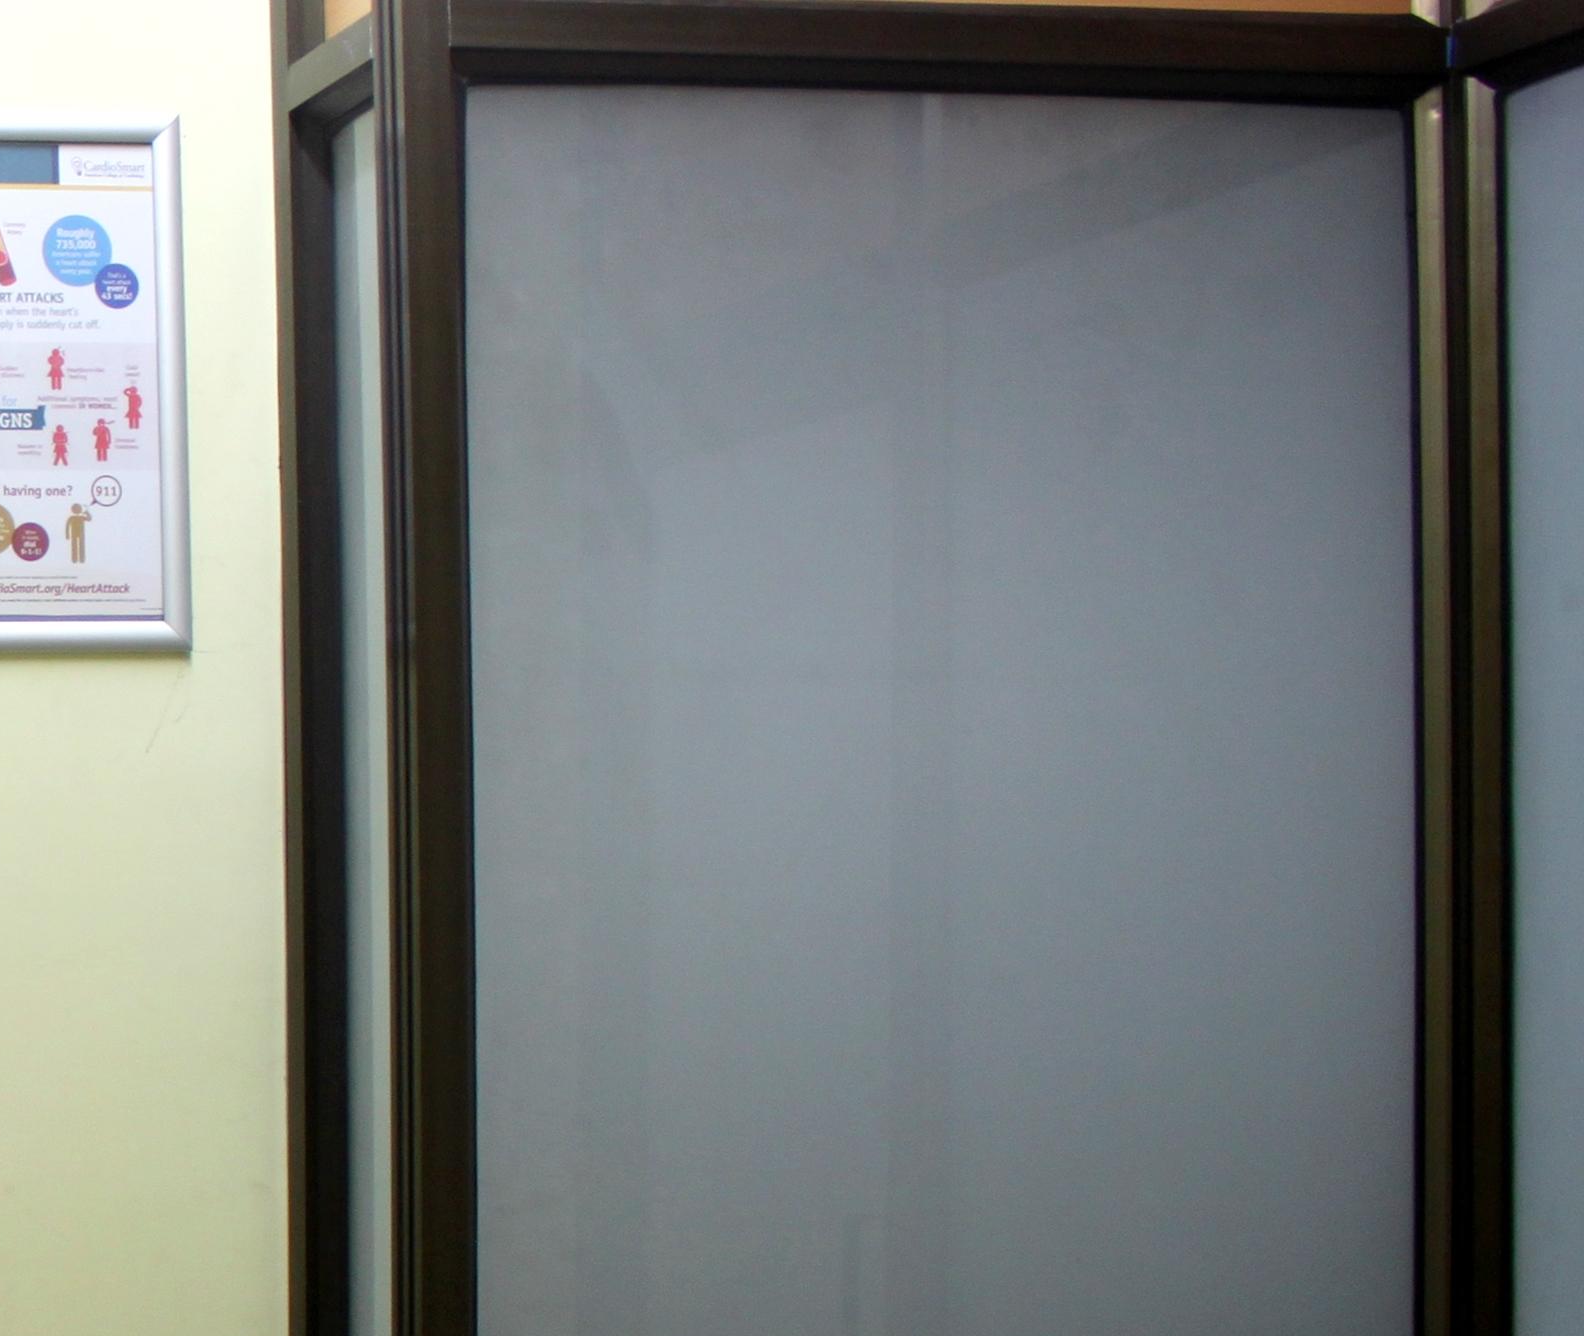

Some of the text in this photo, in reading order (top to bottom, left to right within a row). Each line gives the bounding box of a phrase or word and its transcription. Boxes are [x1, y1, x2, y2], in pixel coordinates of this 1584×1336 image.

[83, 160, 145, 172] CardioSmart
[16, 292, 64, 303] ATTACKS
[6, 308, 29, 316] when
[32, 307, 46, 316] the
[17, 319, 24, 328] is
[27, 319, 65, 330] suddenly
[68, 320, 83, 329] cut
[3, 485, 42, 499] having
[45, 485, 73, 497] one?
[95, 486, 117, 497] 911
